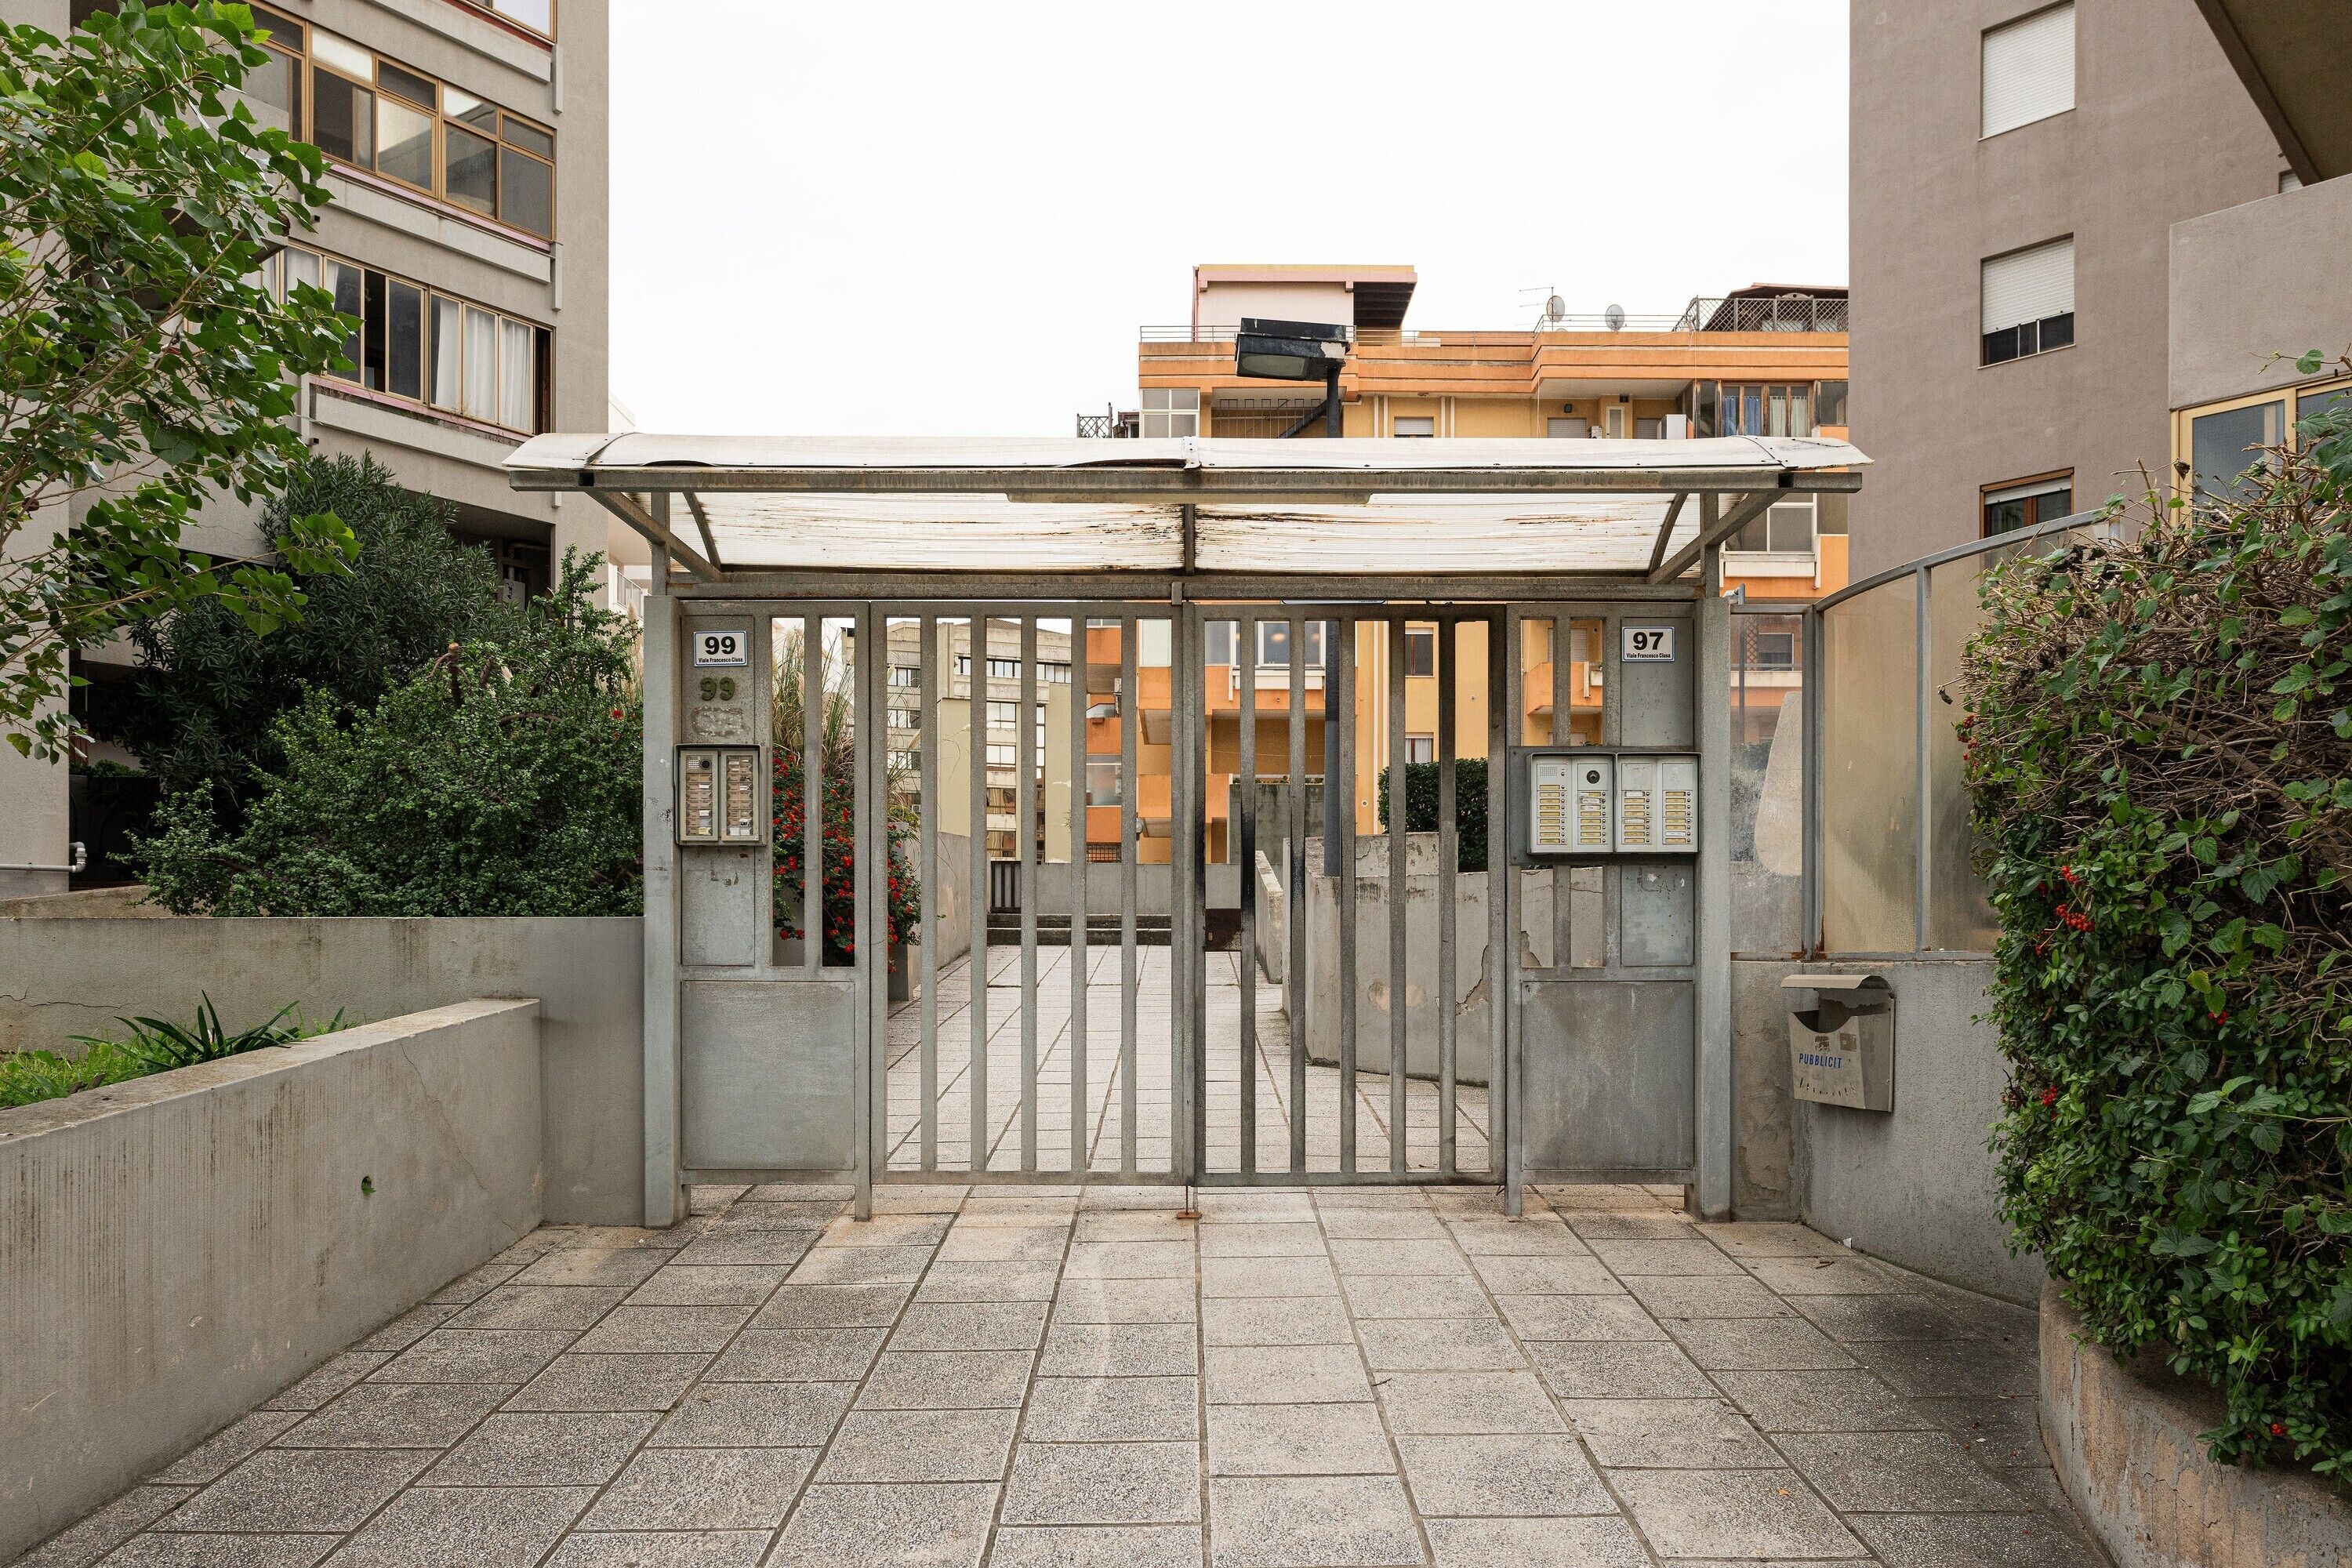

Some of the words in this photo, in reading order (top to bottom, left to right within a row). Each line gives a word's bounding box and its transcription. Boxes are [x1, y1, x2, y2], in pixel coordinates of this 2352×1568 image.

[705, 636, 735, 655] 99
[1633, 632, 1664, 650] 97
[700, 677, 735, 701] 99
[1798, 1053, 1842, 1069] PUBBLICIT
